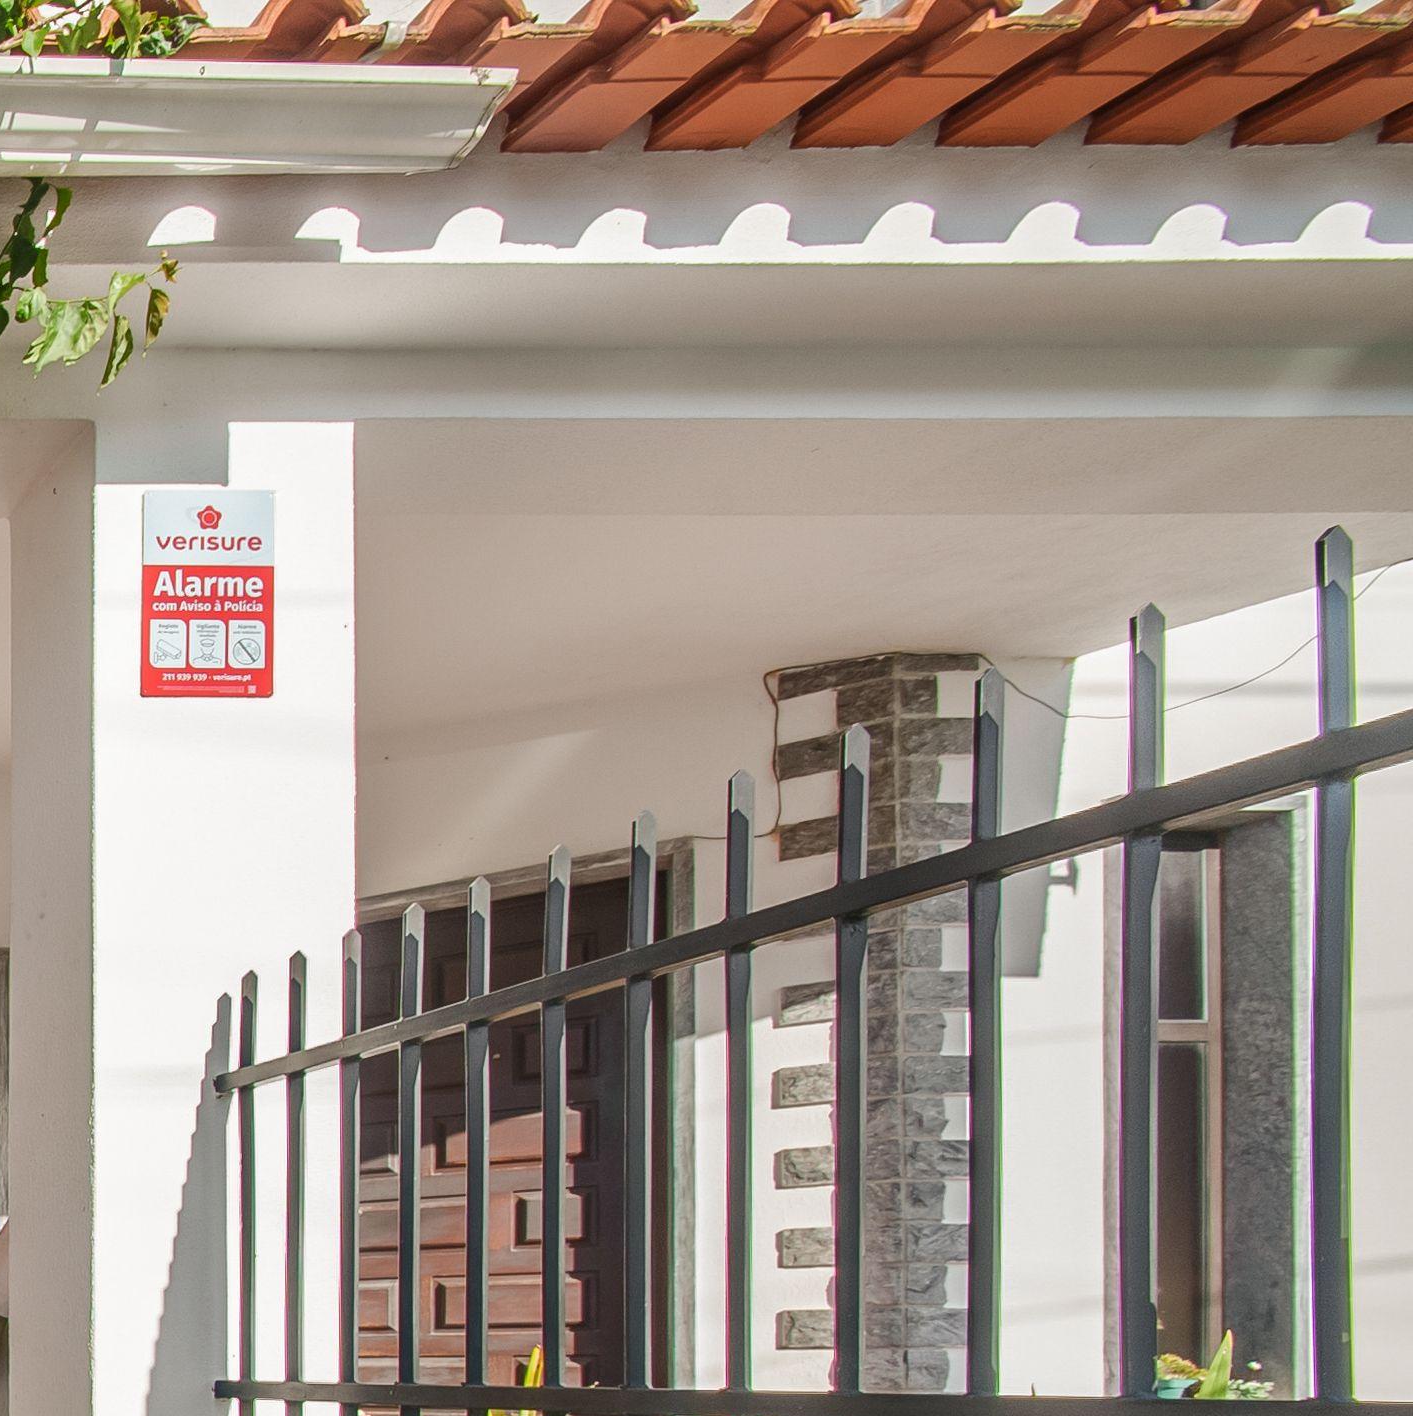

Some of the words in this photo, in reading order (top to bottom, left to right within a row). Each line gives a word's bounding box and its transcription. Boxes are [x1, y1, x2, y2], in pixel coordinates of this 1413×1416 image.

[155, 535, 263, 551] verisure
[153, 568, 264, 598] Alarme
[152, 602, 177, 612] com
[179, 599, 212, 612] Aviso
[214, 600, 222, 612] à
[224, 600, 264, 612] Polícia
